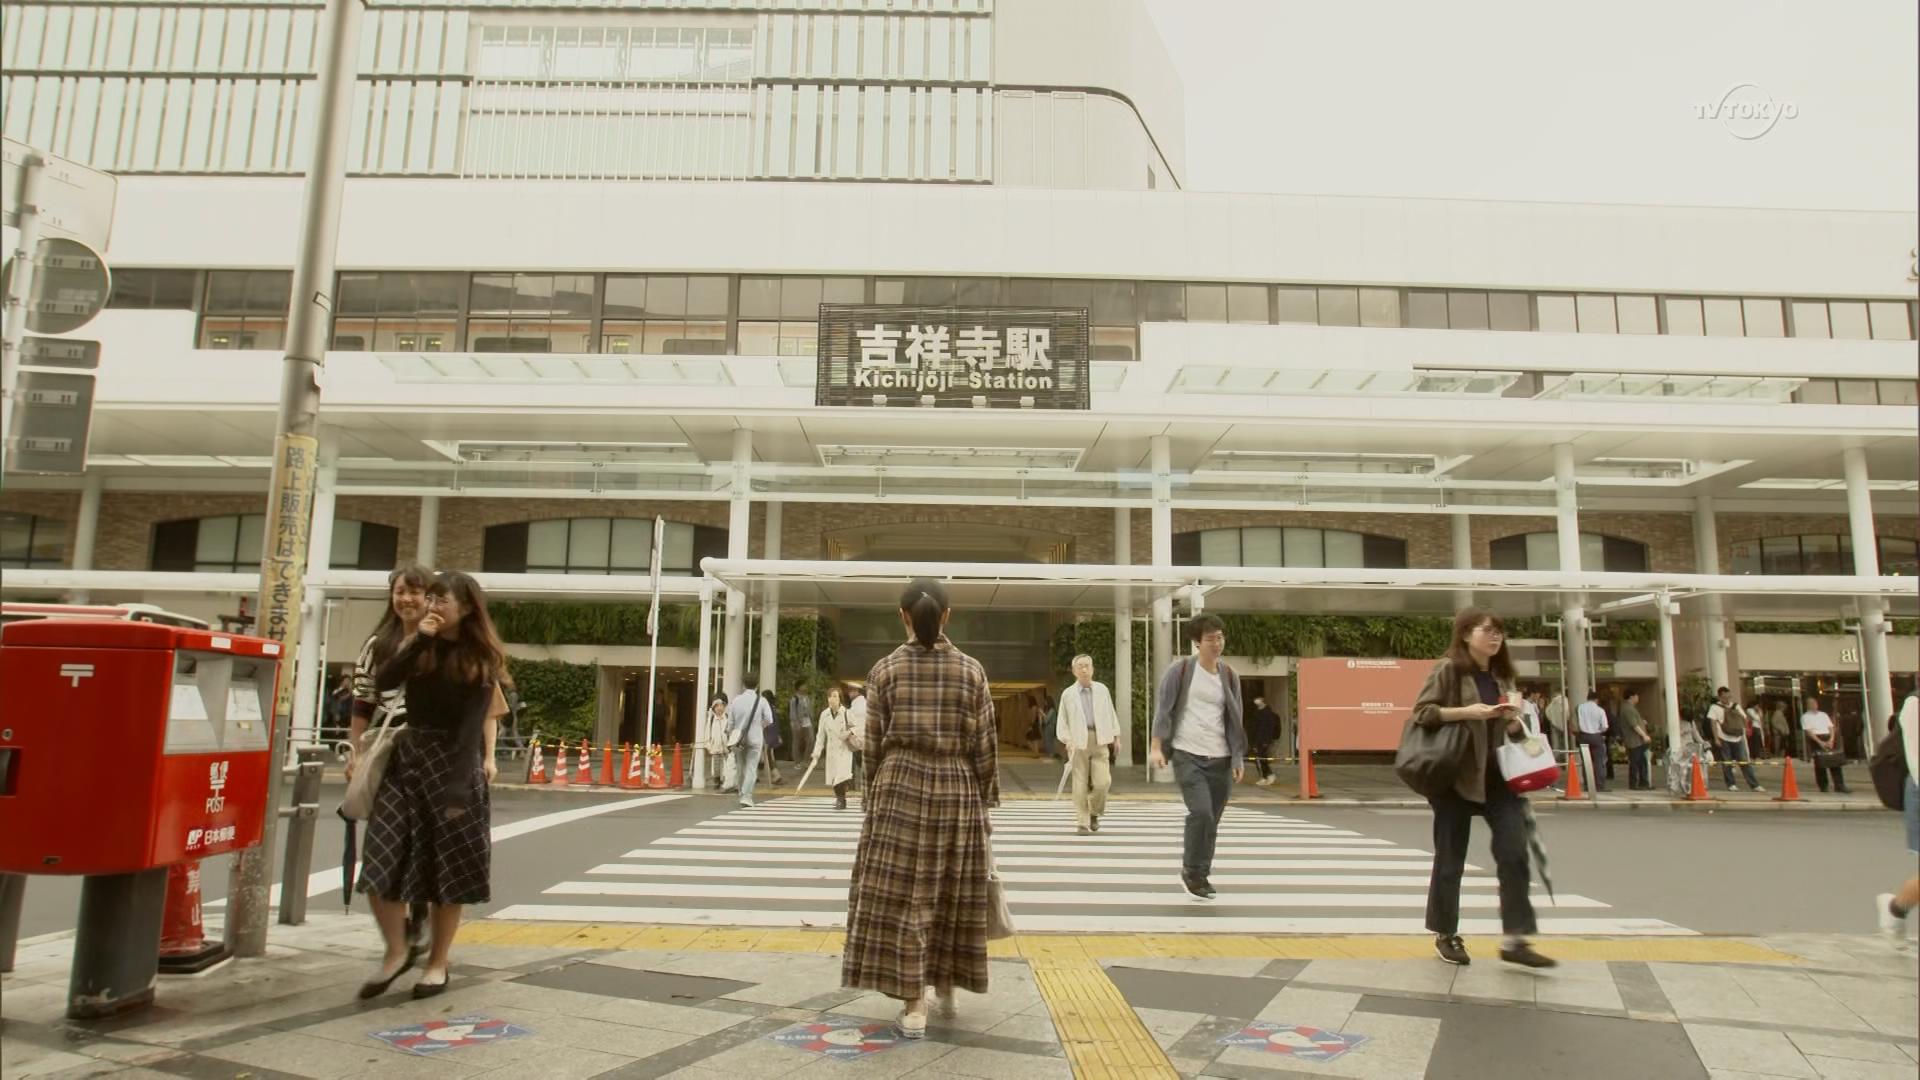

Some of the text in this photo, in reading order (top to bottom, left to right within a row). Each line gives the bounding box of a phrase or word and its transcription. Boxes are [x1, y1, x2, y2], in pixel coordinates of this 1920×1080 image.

[856, 324, 1051, 371] 吉祥寺駅
[968, 371, 1053, 390] Station
[205, 796, 226, 815] POST
